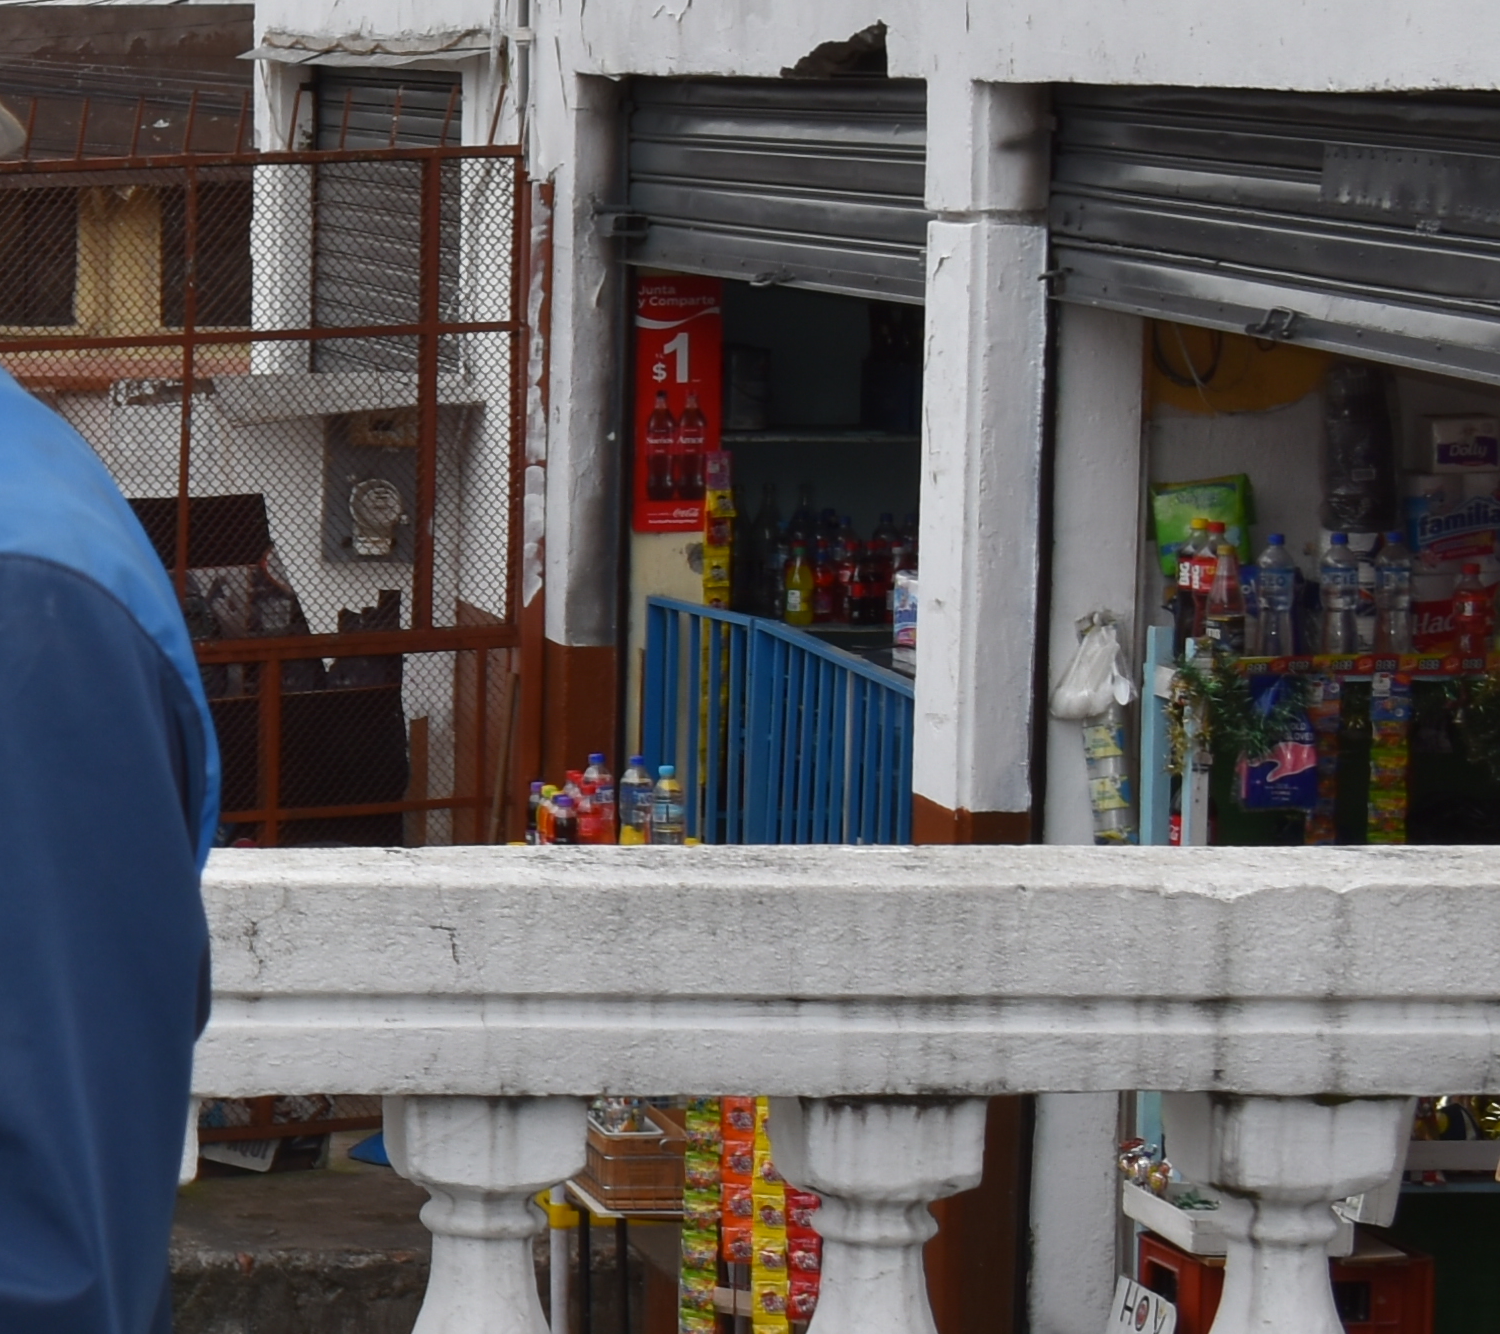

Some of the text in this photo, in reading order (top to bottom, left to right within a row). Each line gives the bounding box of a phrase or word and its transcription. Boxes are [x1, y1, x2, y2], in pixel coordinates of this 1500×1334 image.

[638, 286, 676, 295] Junta
[638, 296, 715, 308] y Comparte
[1449, 443, 1488, 458] Dolly
[1419, 501, 1500, 536] familia
